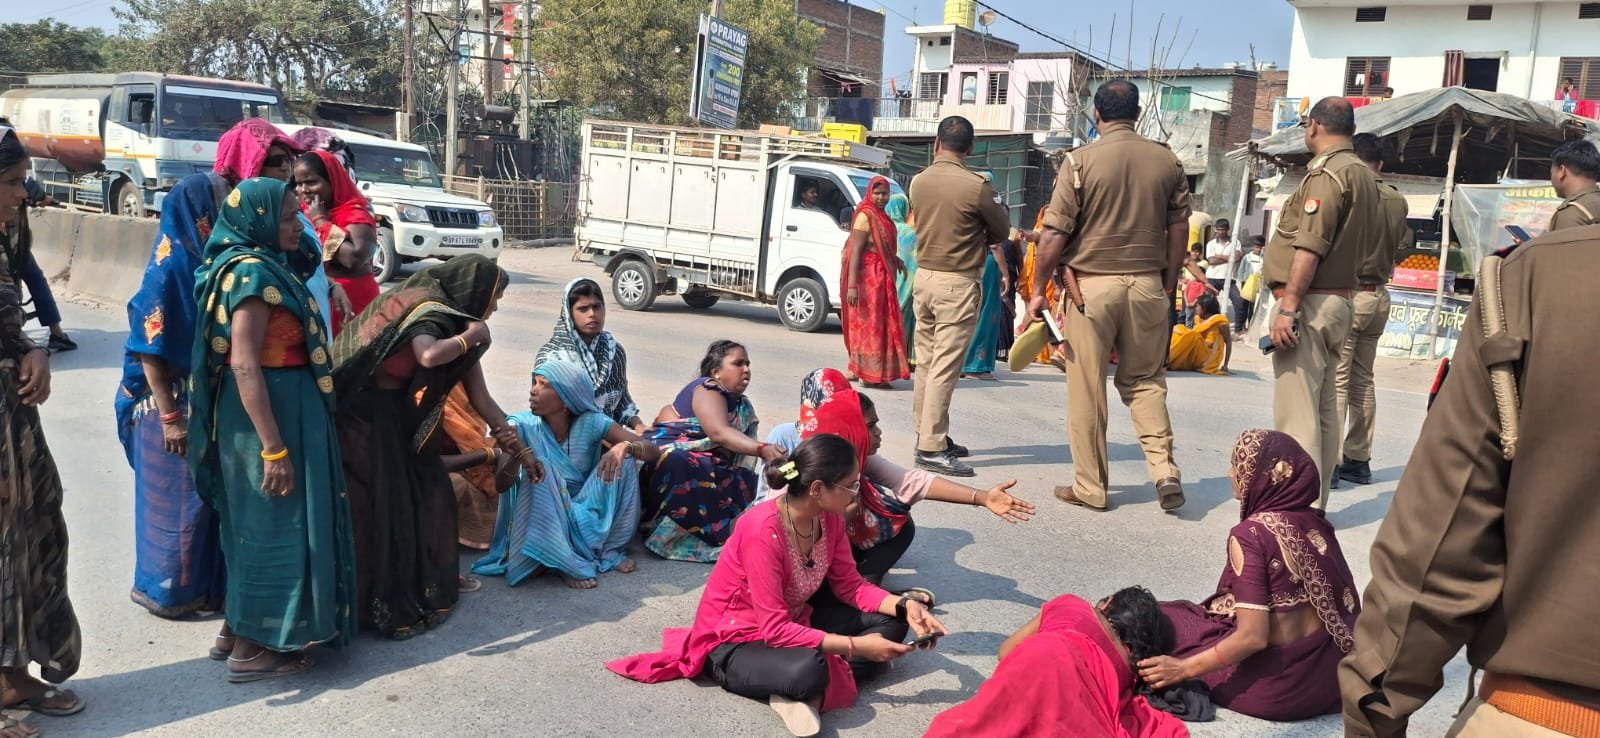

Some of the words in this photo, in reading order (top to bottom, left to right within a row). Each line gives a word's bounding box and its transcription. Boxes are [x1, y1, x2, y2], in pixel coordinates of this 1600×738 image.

[717, 23, 747, 47] PRAYAG
[1388, 299, 1408, 322] एवं
[1407, 306, 1431, 332] फ्रूट
